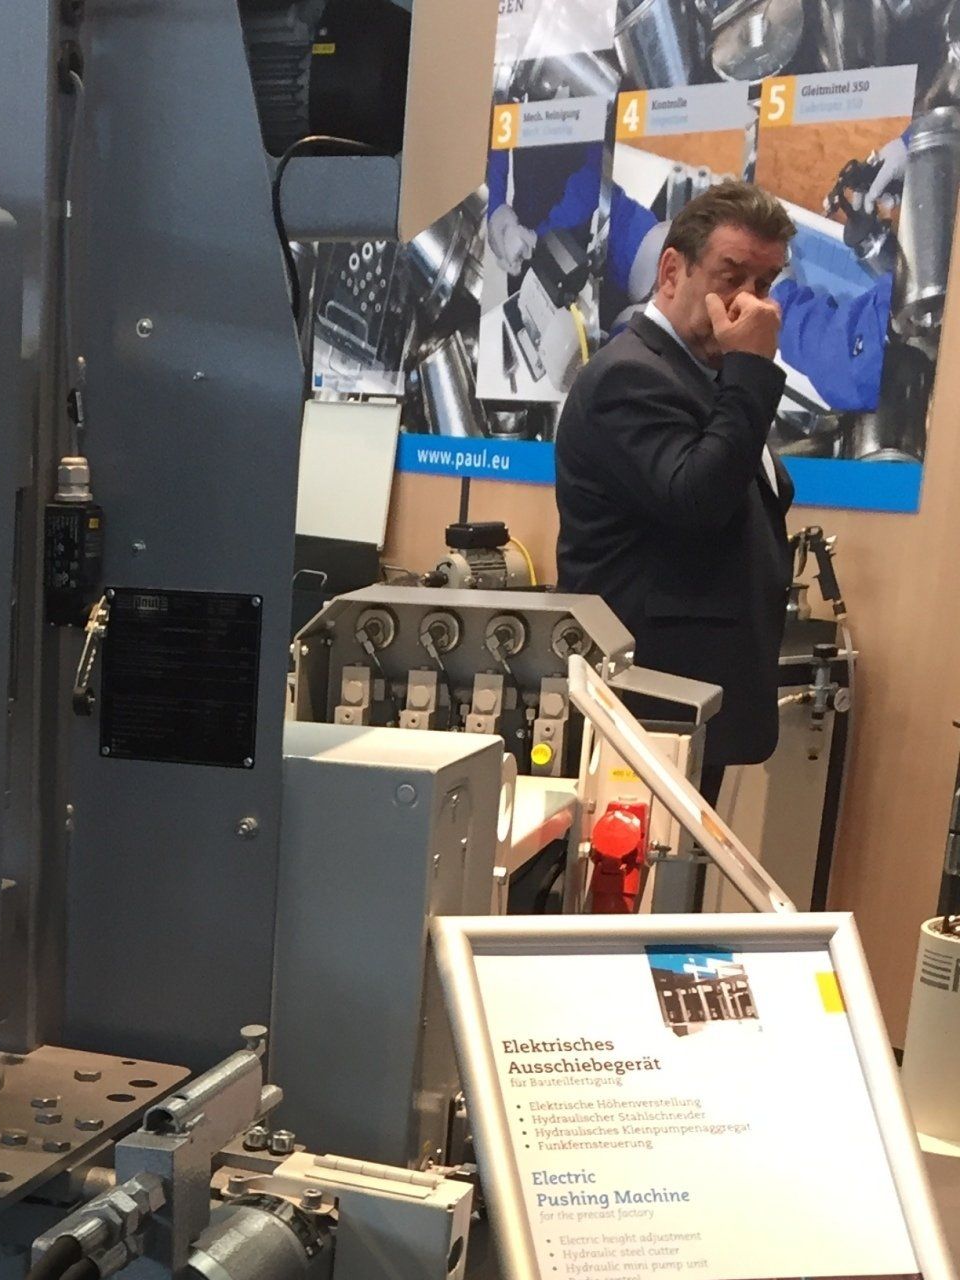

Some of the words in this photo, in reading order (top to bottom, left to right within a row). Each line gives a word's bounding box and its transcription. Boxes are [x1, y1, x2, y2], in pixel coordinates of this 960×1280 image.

[801, 82, 850, 97] Gleitmittel
[852, 81, 870, 93] 350
[768, 84, 786, 120] 5
[623, 98, 640, 132] 4
[497, 111, 512, 143] 3
[417, 449, 510, 470] www.paul.eu
[502, 1038, 615, 1054] Elektrisches
[508, 1056, 661, 1075] Ausschiebegerät
[510, 1077, 527, 1088] für
[530, 1075, 623, 1087] Bauteilfertigung
[529, 1100, 594, 1111] Elektrische
[597, 1097, 702, 1109] Höhenverstellung
[532, 1113, 614, 1126] Hydraulischer
[618, 1110, 706, 1122] Stahlschneider
[535, 1126, 619, 1139] Hydraulisches
[622, 1123, 751, 1137] Kleinpumpenaggregat
[538, 1138, 653, 1151] Funkfernsteuerung
[532, 1169, 596, 1185] Electric
[537, 1191, 609, 1209] Pushing
[614, 1188, 690, 1204] Machine
[539, 1211, 554, 1224] for
[558, 1210, 574, 1220] the
[577, 1210, 615, 1222] precast
[618, 1208, 654, 1221] factory
[559, 1235, 598, 1246] Electric
[602, 1234, 637, 1246] height
[640, 1232, 702, 1244] adjustment
[562, 1249, 616, 1261] Hydraulic
[620, 1247, 645, 1257] steel
[648, 1247, 679, 1257] cutter
[565, 1263, 620, 1276] Hydraulic
[623, 1261, 648, 1271] mini
[651, 1261, 683, 1273] pump
[686, 1259, 709, 1269] unit
